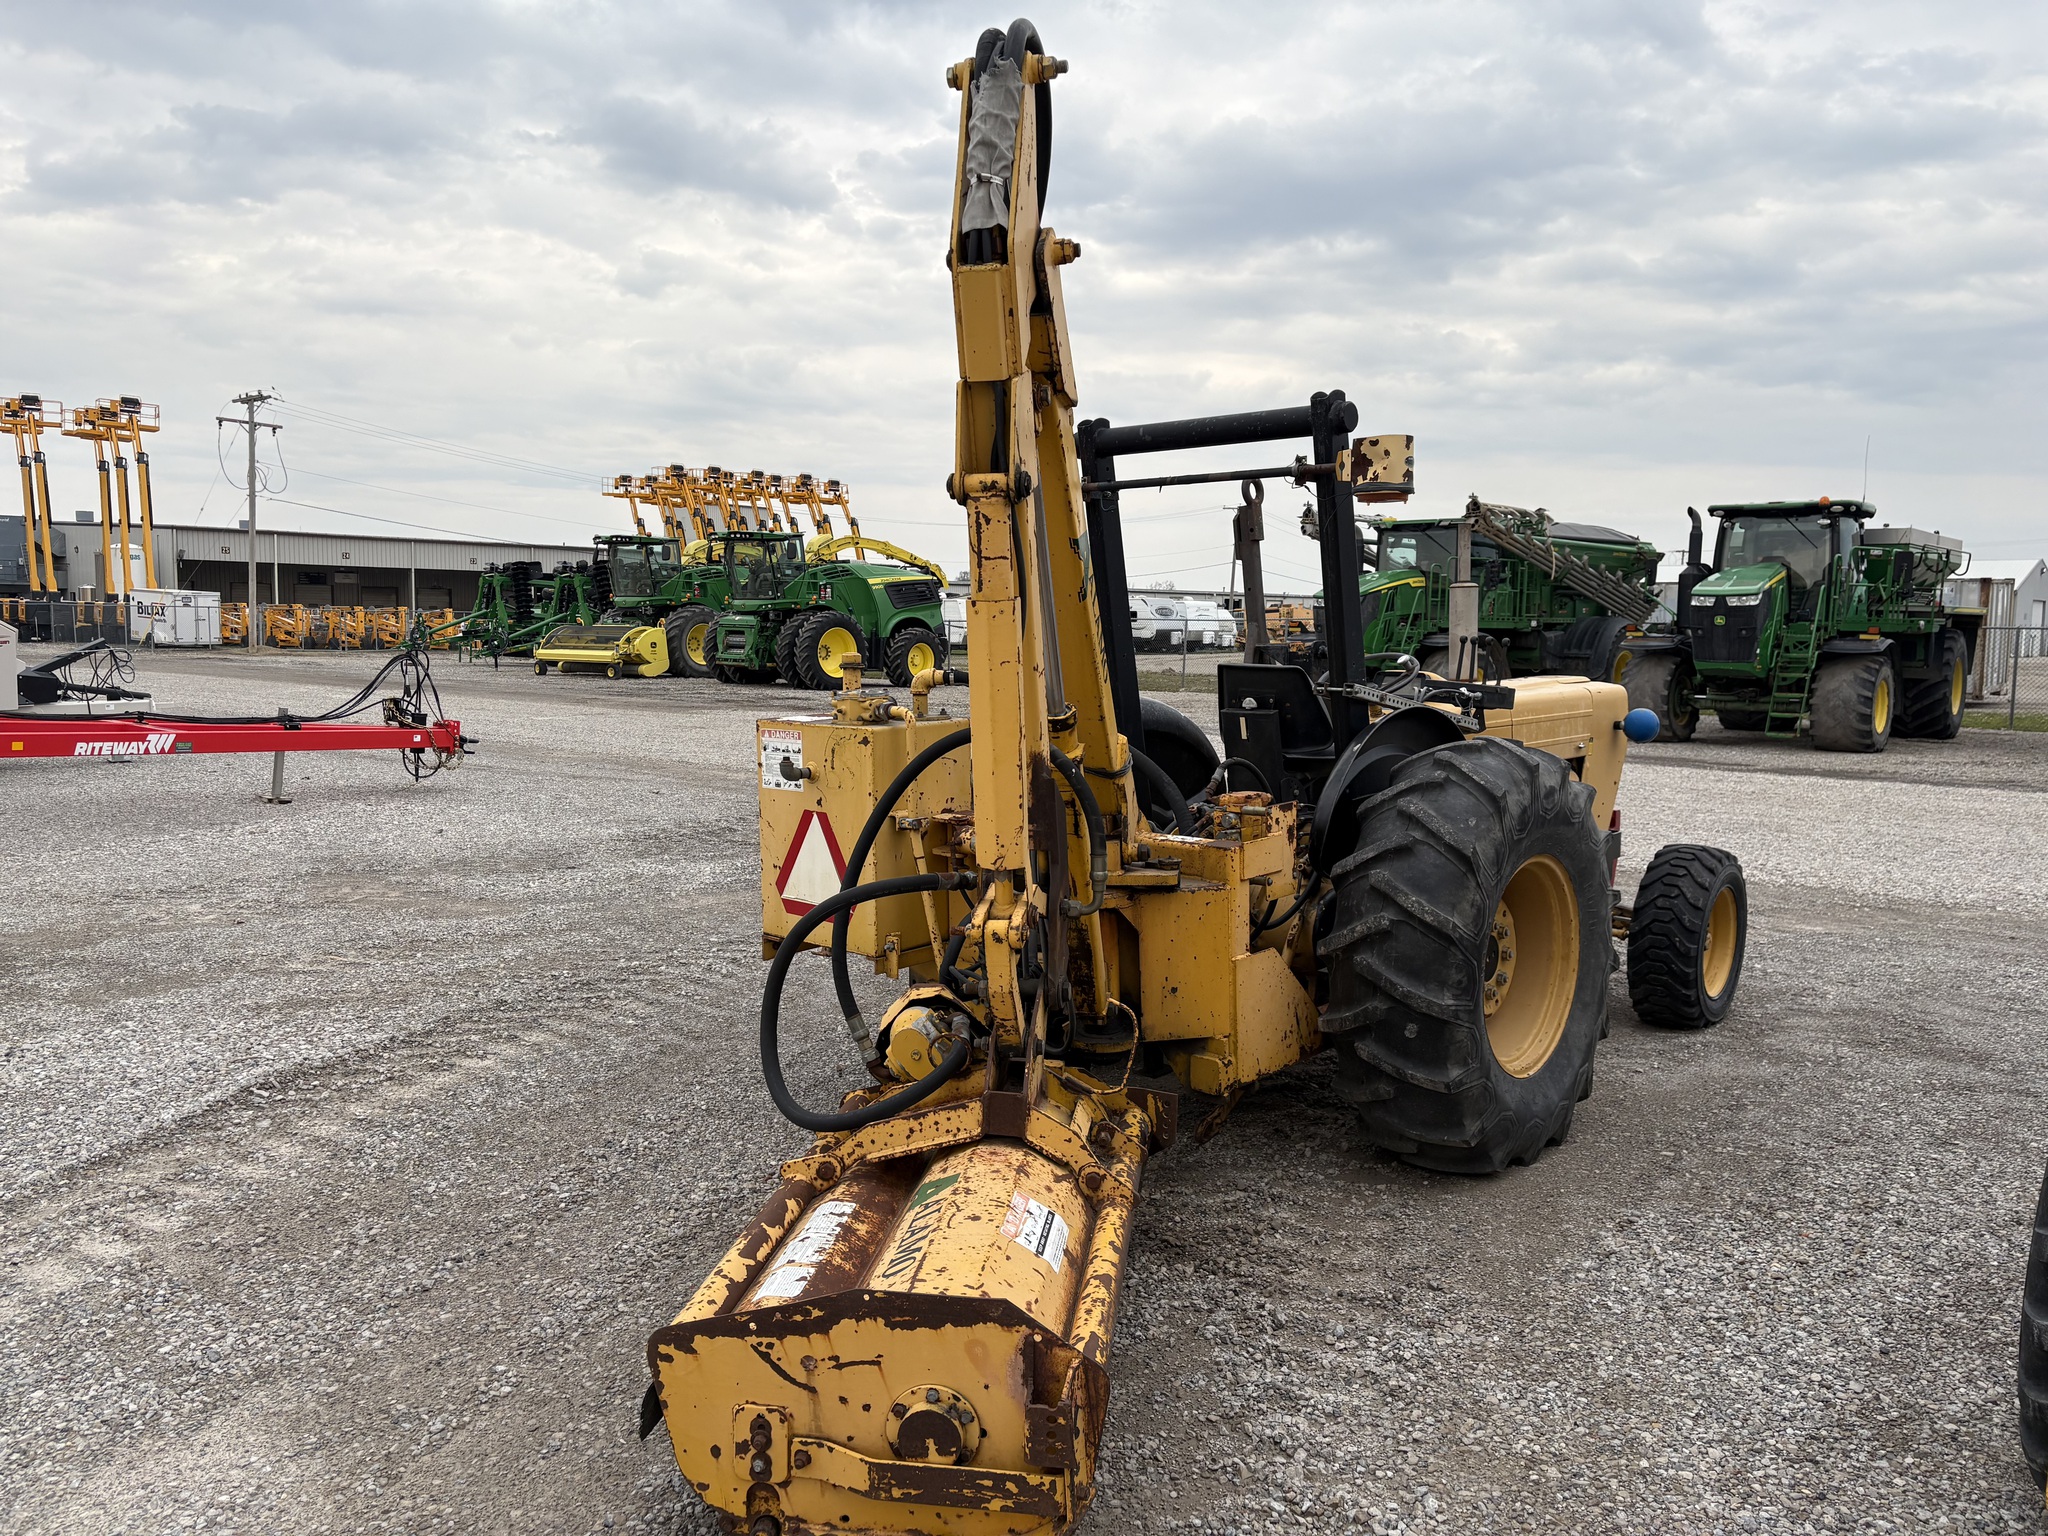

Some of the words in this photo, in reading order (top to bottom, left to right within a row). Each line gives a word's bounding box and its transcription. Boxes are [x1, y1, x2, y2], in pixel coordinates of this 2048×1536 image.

[137, 601, 166, 618] BILAX
[771, 730, 799, 739] DANGER
[74, 741, 149, 756] RITEWAY
[882, 1197, 949, 1279] ALAMO
